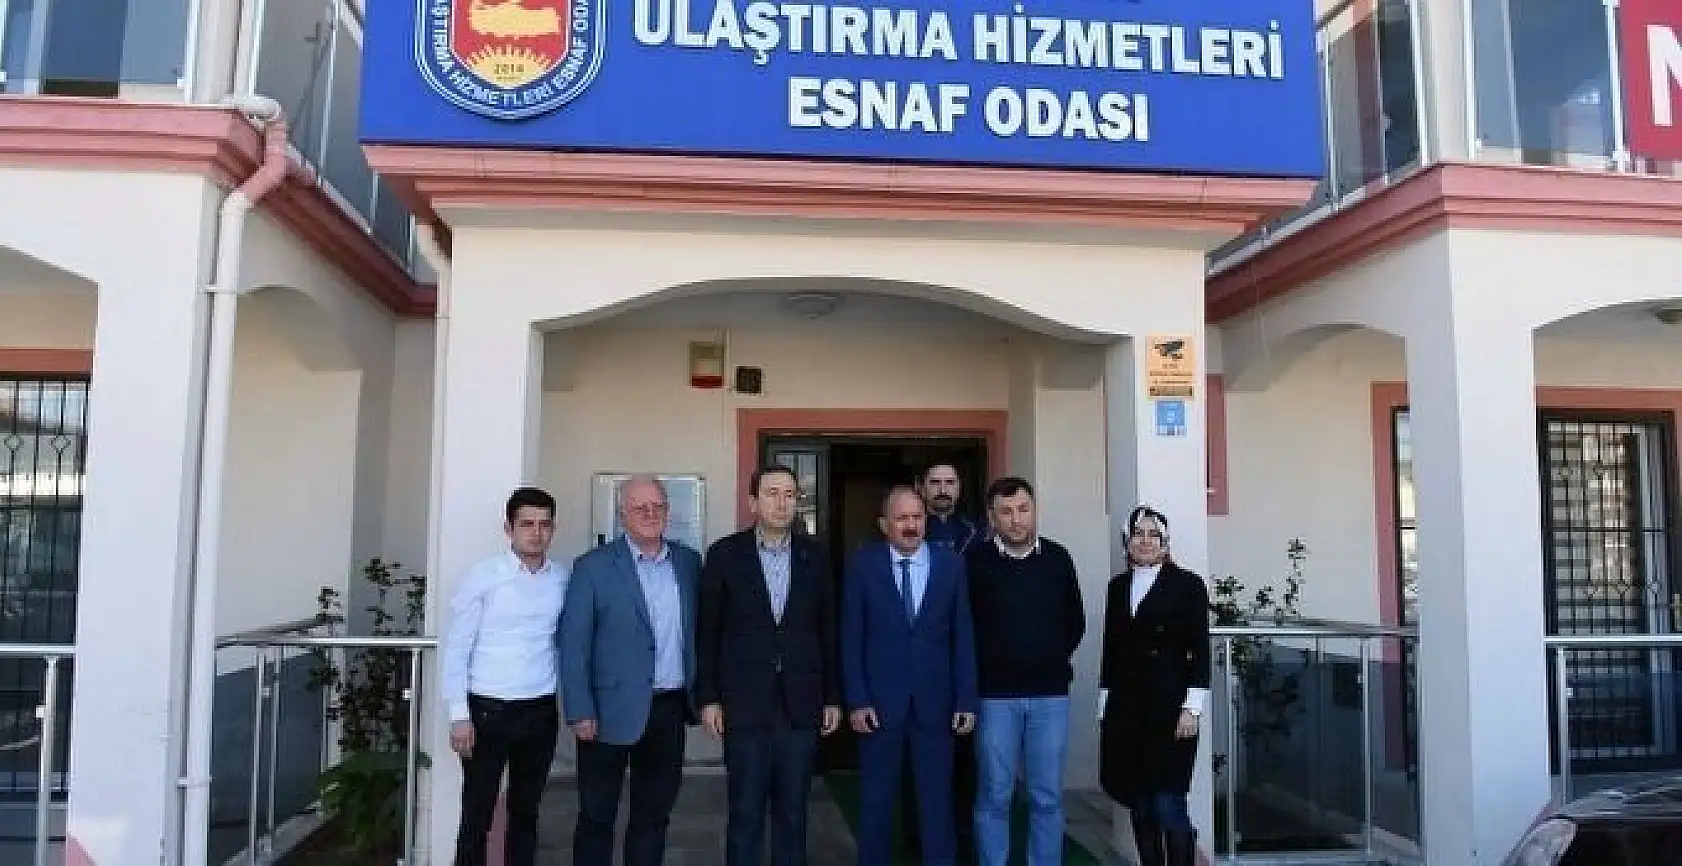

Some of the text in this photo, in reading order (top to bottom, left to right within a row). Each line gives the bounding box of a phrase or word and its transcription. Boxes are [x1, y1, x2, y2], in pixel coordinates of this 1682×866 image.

[634, 0, 1283, 78] ULAŞTIRMA HİZMETLERİ
[790, 78, 1148, 142] ESNAF ODASI
